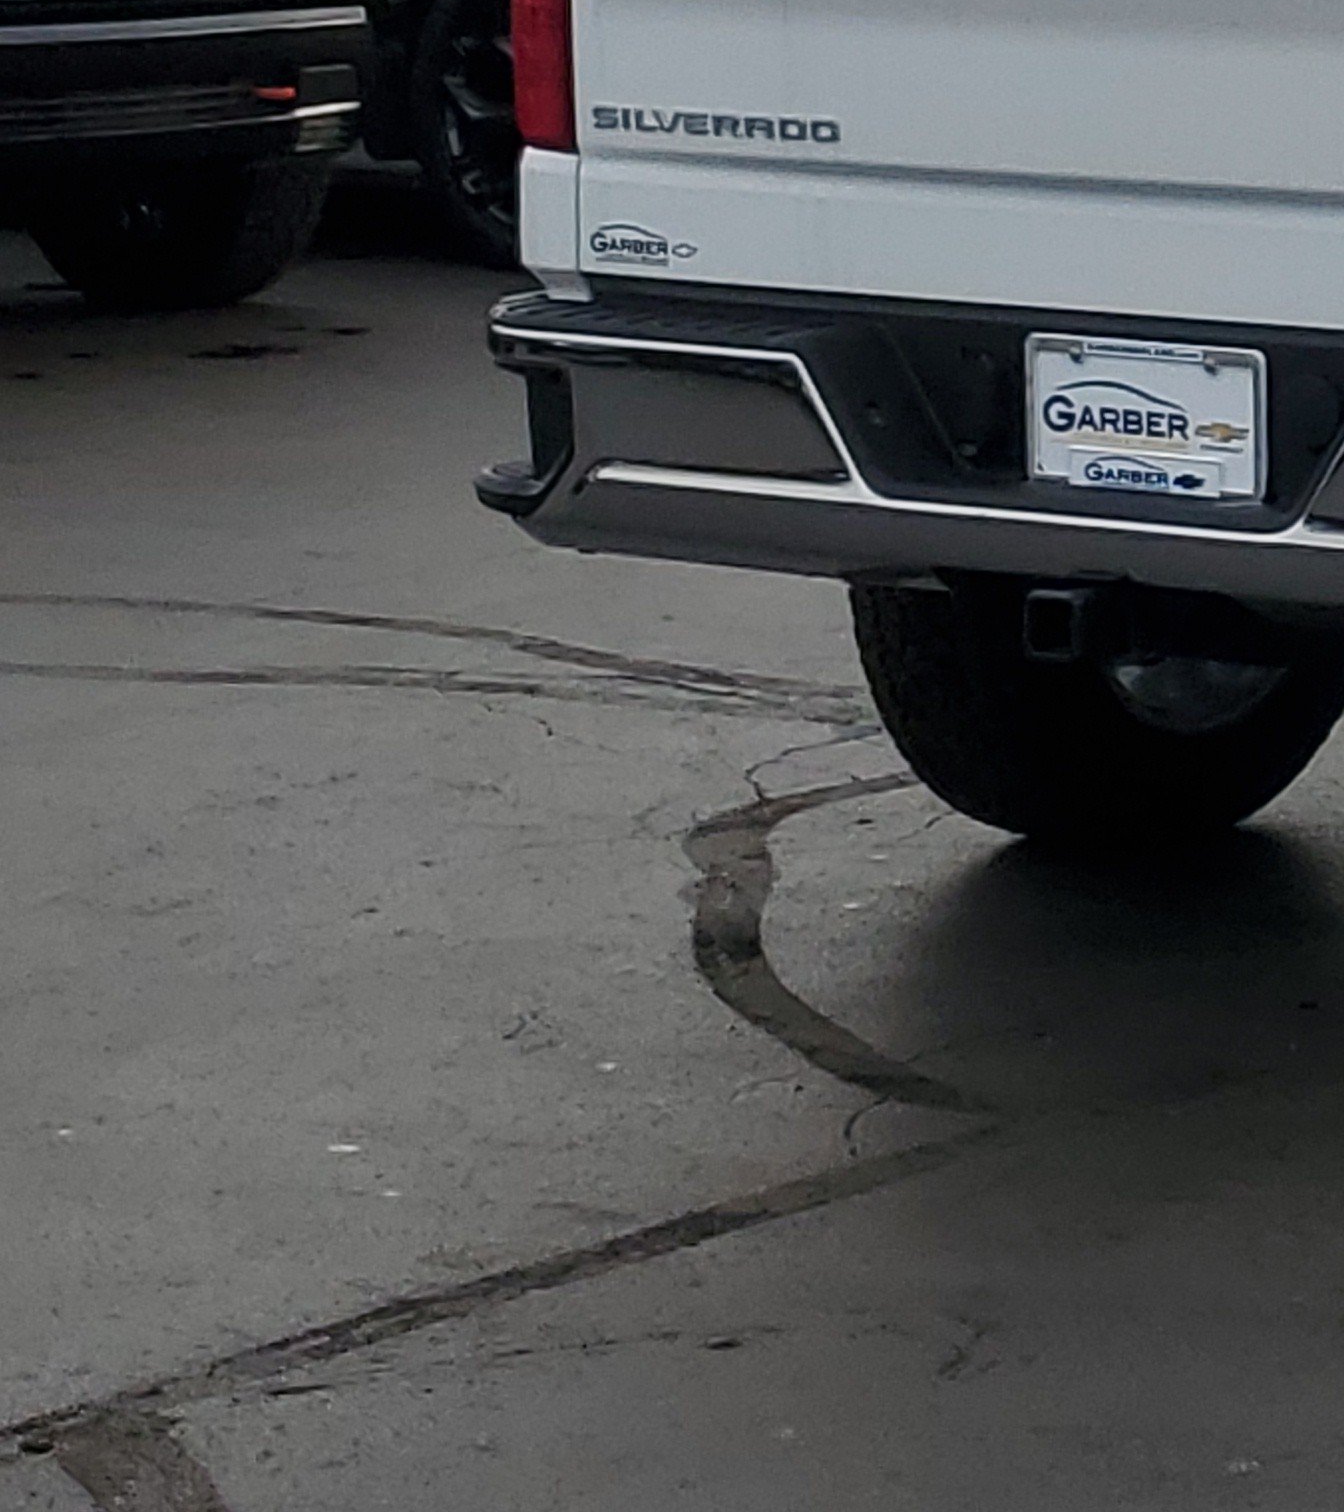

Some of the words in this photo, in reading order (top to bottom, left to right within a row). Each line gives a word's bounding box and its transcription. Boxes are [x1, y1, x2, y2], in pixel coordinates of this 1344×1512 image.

[592, 106, 842, 143] SILVERADO
[590, 231, 669, 257] GARBER
[1043, 394, 1190, 441] GARBER
[1084, 462, 1169, 487] GARBER
